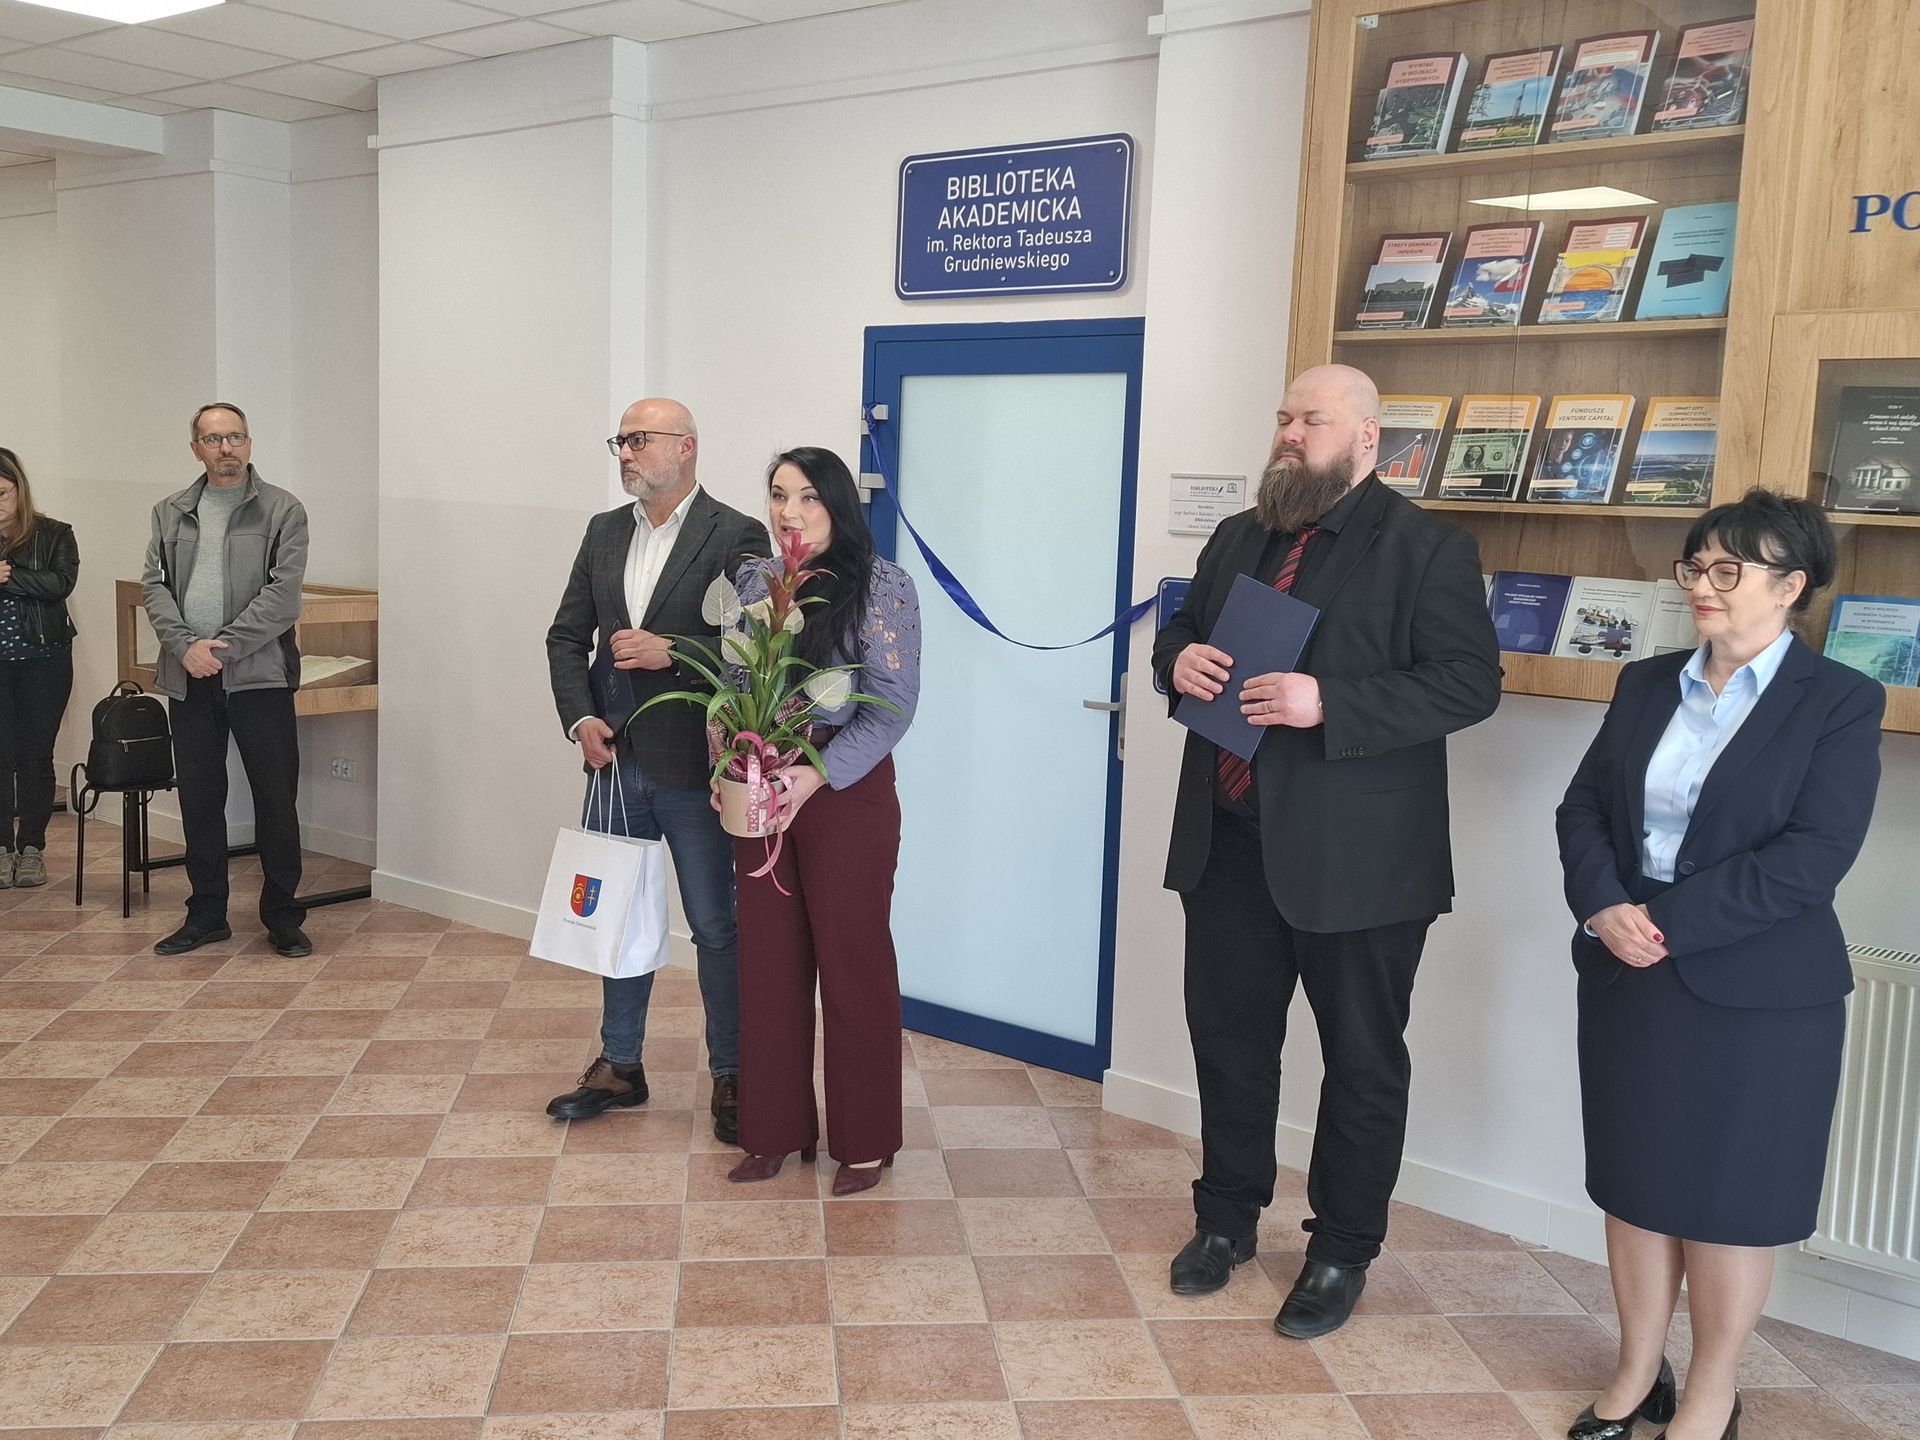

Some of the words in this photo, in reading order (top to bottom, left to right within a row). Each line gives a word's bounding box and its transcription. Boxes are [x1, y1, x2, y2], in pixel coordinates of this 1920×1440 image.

[947, 166, 1076, 201] BIBLIOTEKA
[937, 195, 1082, 230] AKADEMICKA
[926, 236, 949, 253] im.
[953, 234, 1012, 252] Rektora
[1017, 228, 1092, 247] Tadeusza
[944, 250, 1070, 273] Grudniewskiego
